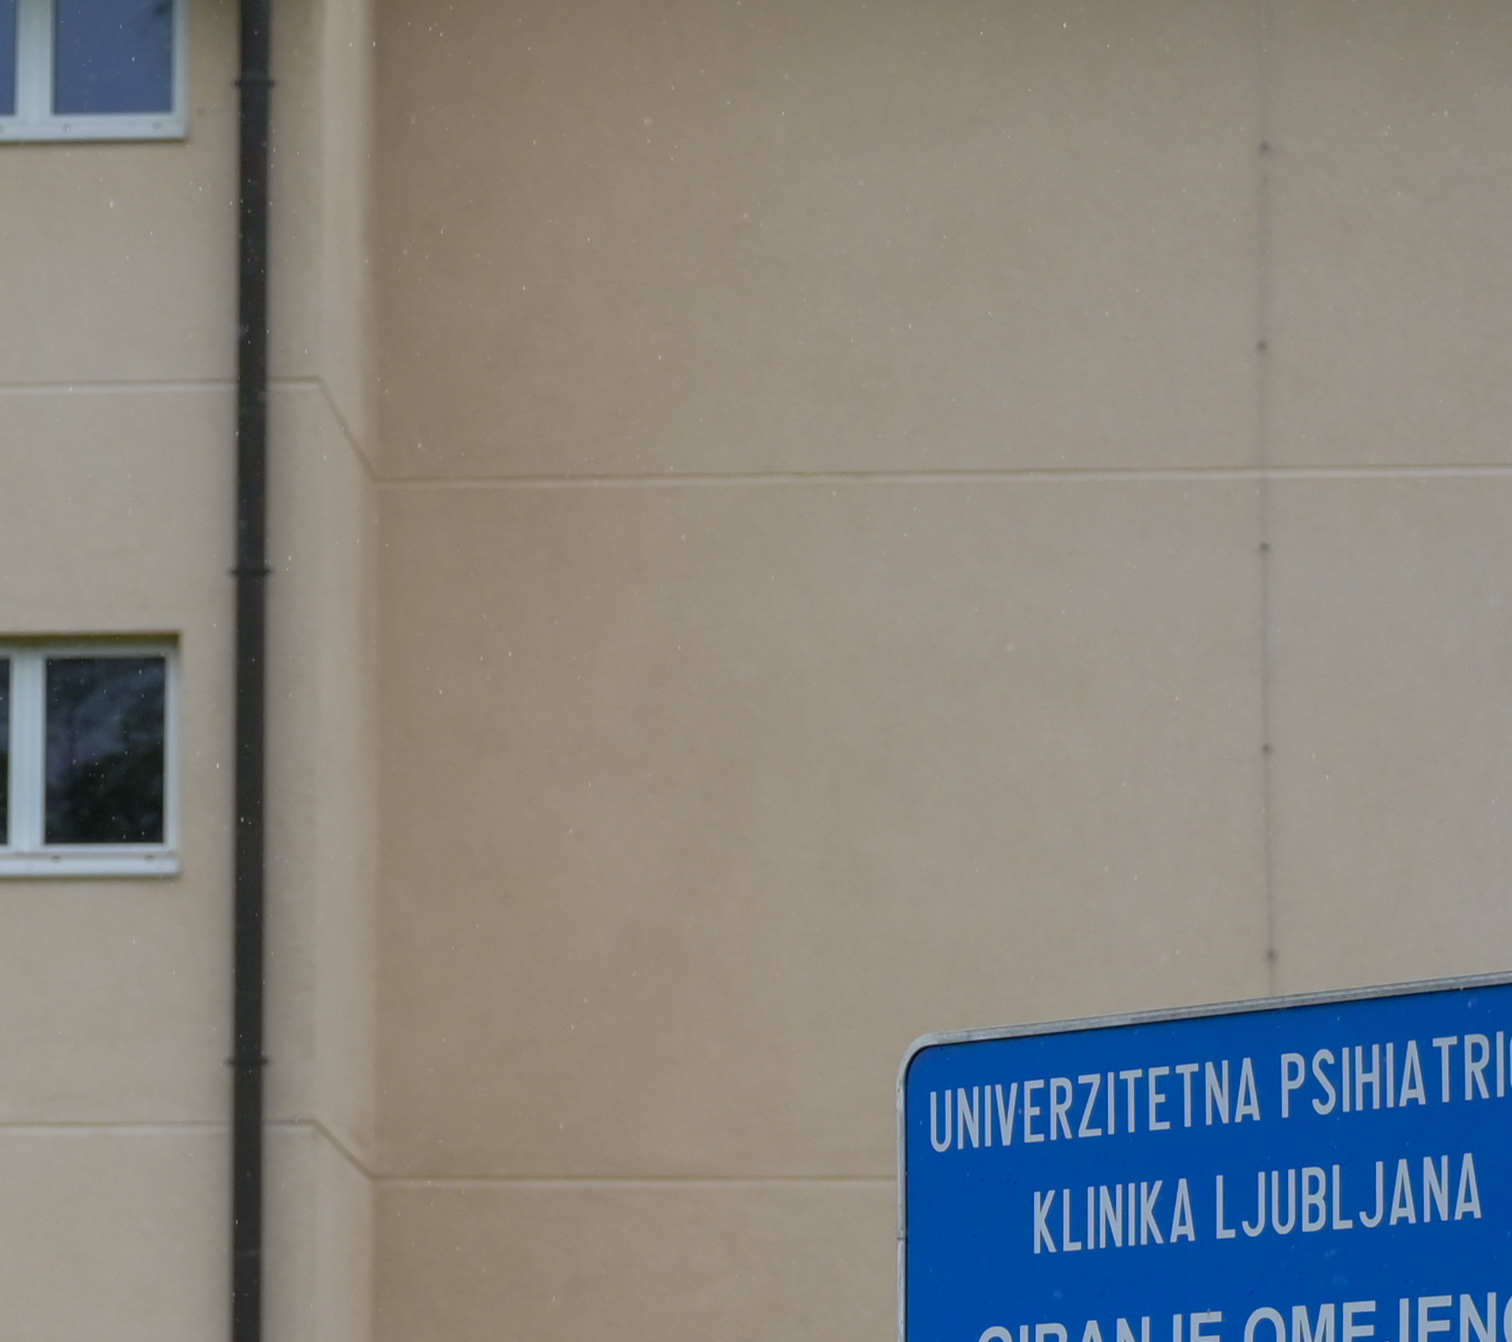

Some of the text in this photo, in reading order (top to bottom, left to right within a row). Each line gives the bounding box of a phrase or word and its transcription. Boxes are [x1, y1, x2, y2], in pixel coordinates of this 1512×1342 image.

[930, 1057, 1261, 1153] UNIVERZITETNA
[1033, 1152, 1482, 1254] KLINIKA LJUBLJANA
